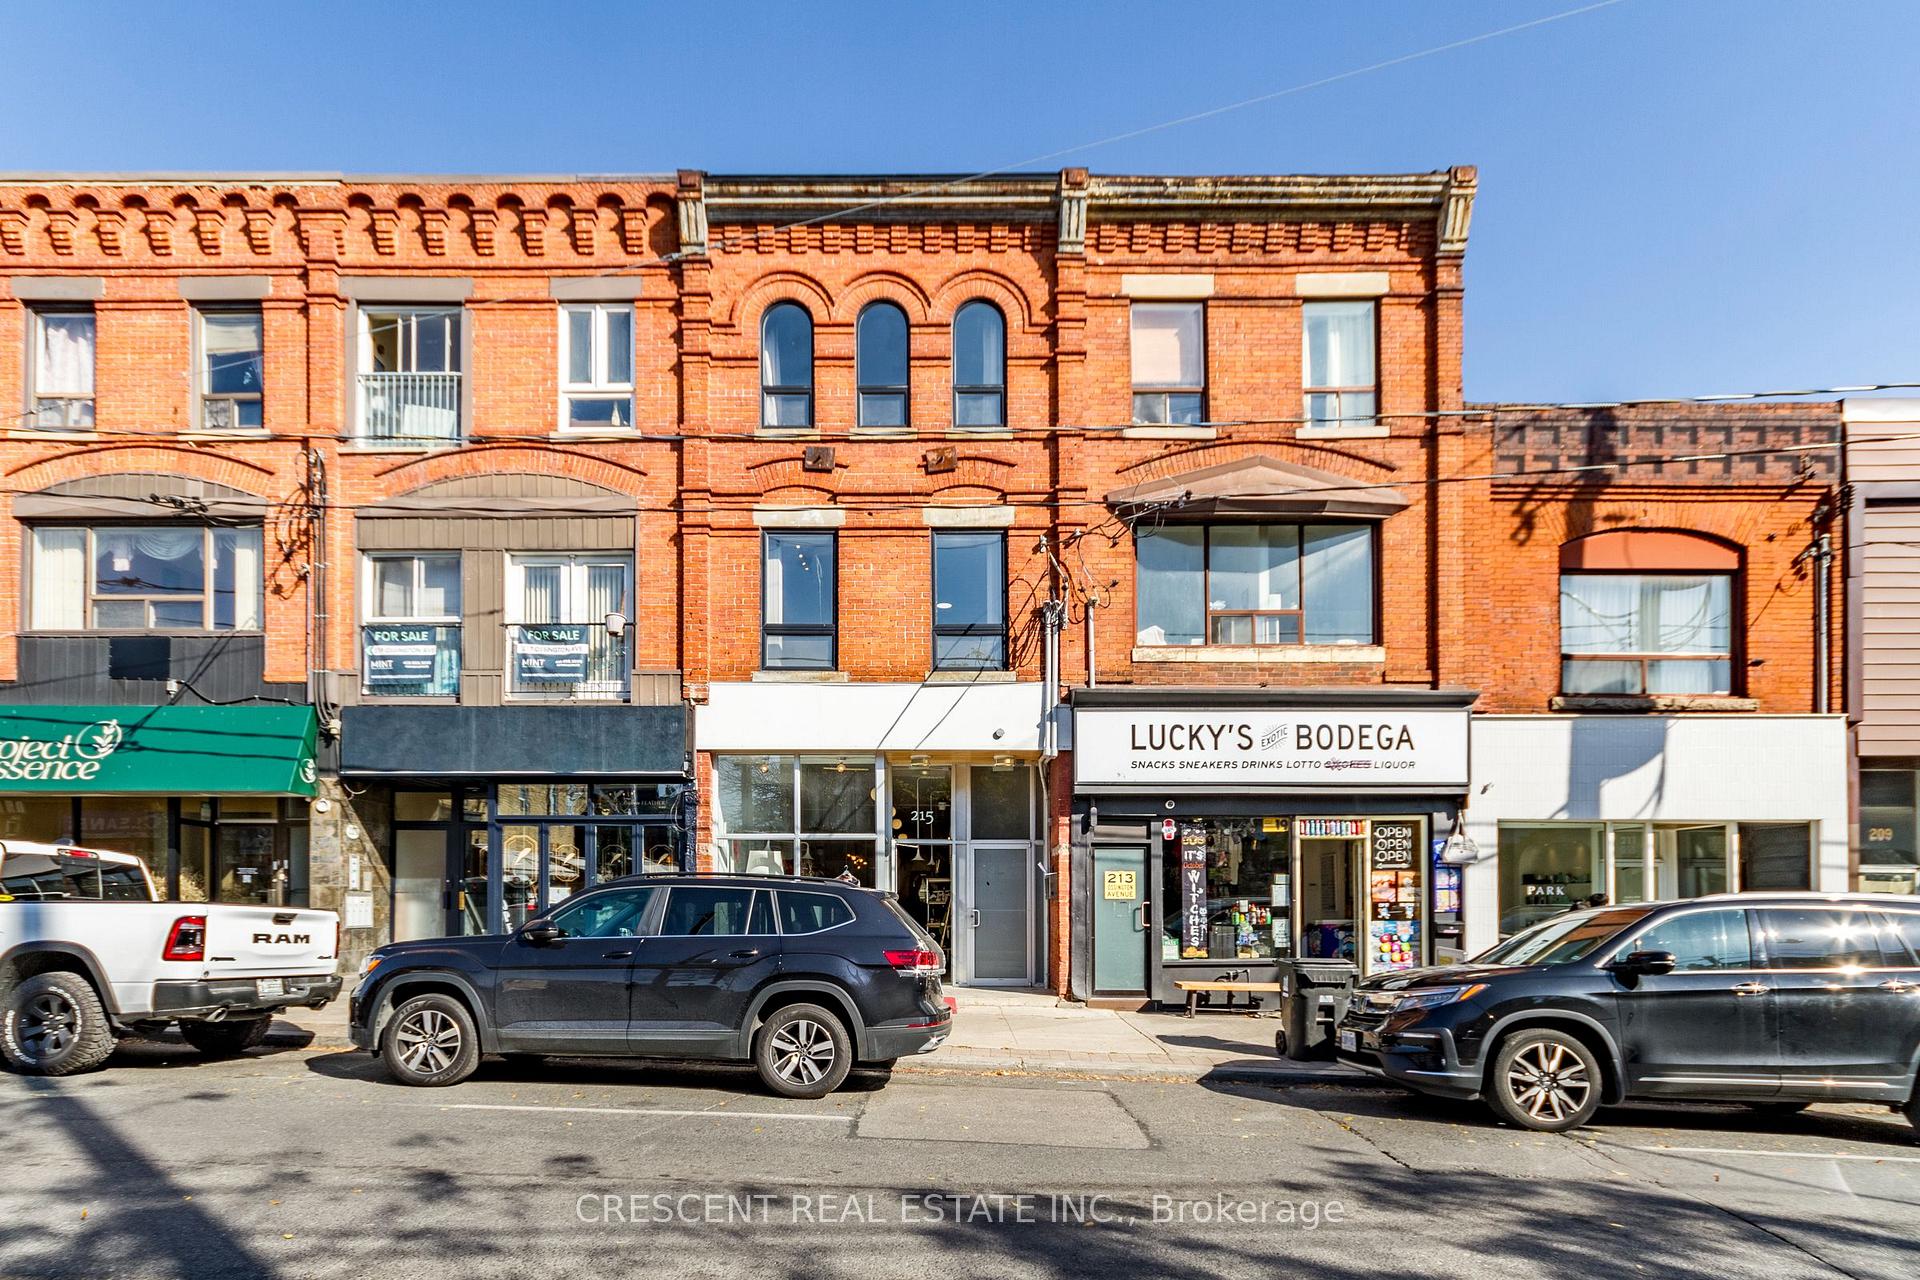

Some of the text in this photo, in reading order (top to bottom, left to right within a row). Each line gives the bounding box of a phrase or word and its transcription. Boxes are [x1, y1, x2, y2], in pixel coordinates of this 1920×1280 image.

[374, 631, 429, 641] FOR SALE
[527, 630, 580, 640] FOR SALE
[370, 660, 393, 668] MINT
[521, 658, 545, 667] MINT
[1131, 724, 1415, 751] LUCKY'S EXOTIC BODEGA
[0, 734, 73, 766] oject
[1131, 760, 1175, 769] SNACKS
[1178, 760, 1239, 769] SNEAKERS
[1241, 760, 1283, 769] DRINKS
[1286, 760, 1321, 769] LOTTO
[1374, 760, 1416, 769] LIQUOR
[910, 810, 934, 825] 215
[1375, 826, 1412, 838] OPEN
[1869, 828, 1893, 841] 209
[1375, 838, 1412, 850] OPEN
[1375, 850, 1412, 862] OPEN
[1107, 873, 1134, 884] 213
[1526, 885, 1566, 896] PARK
[252, 933, 311, 944] RAM
